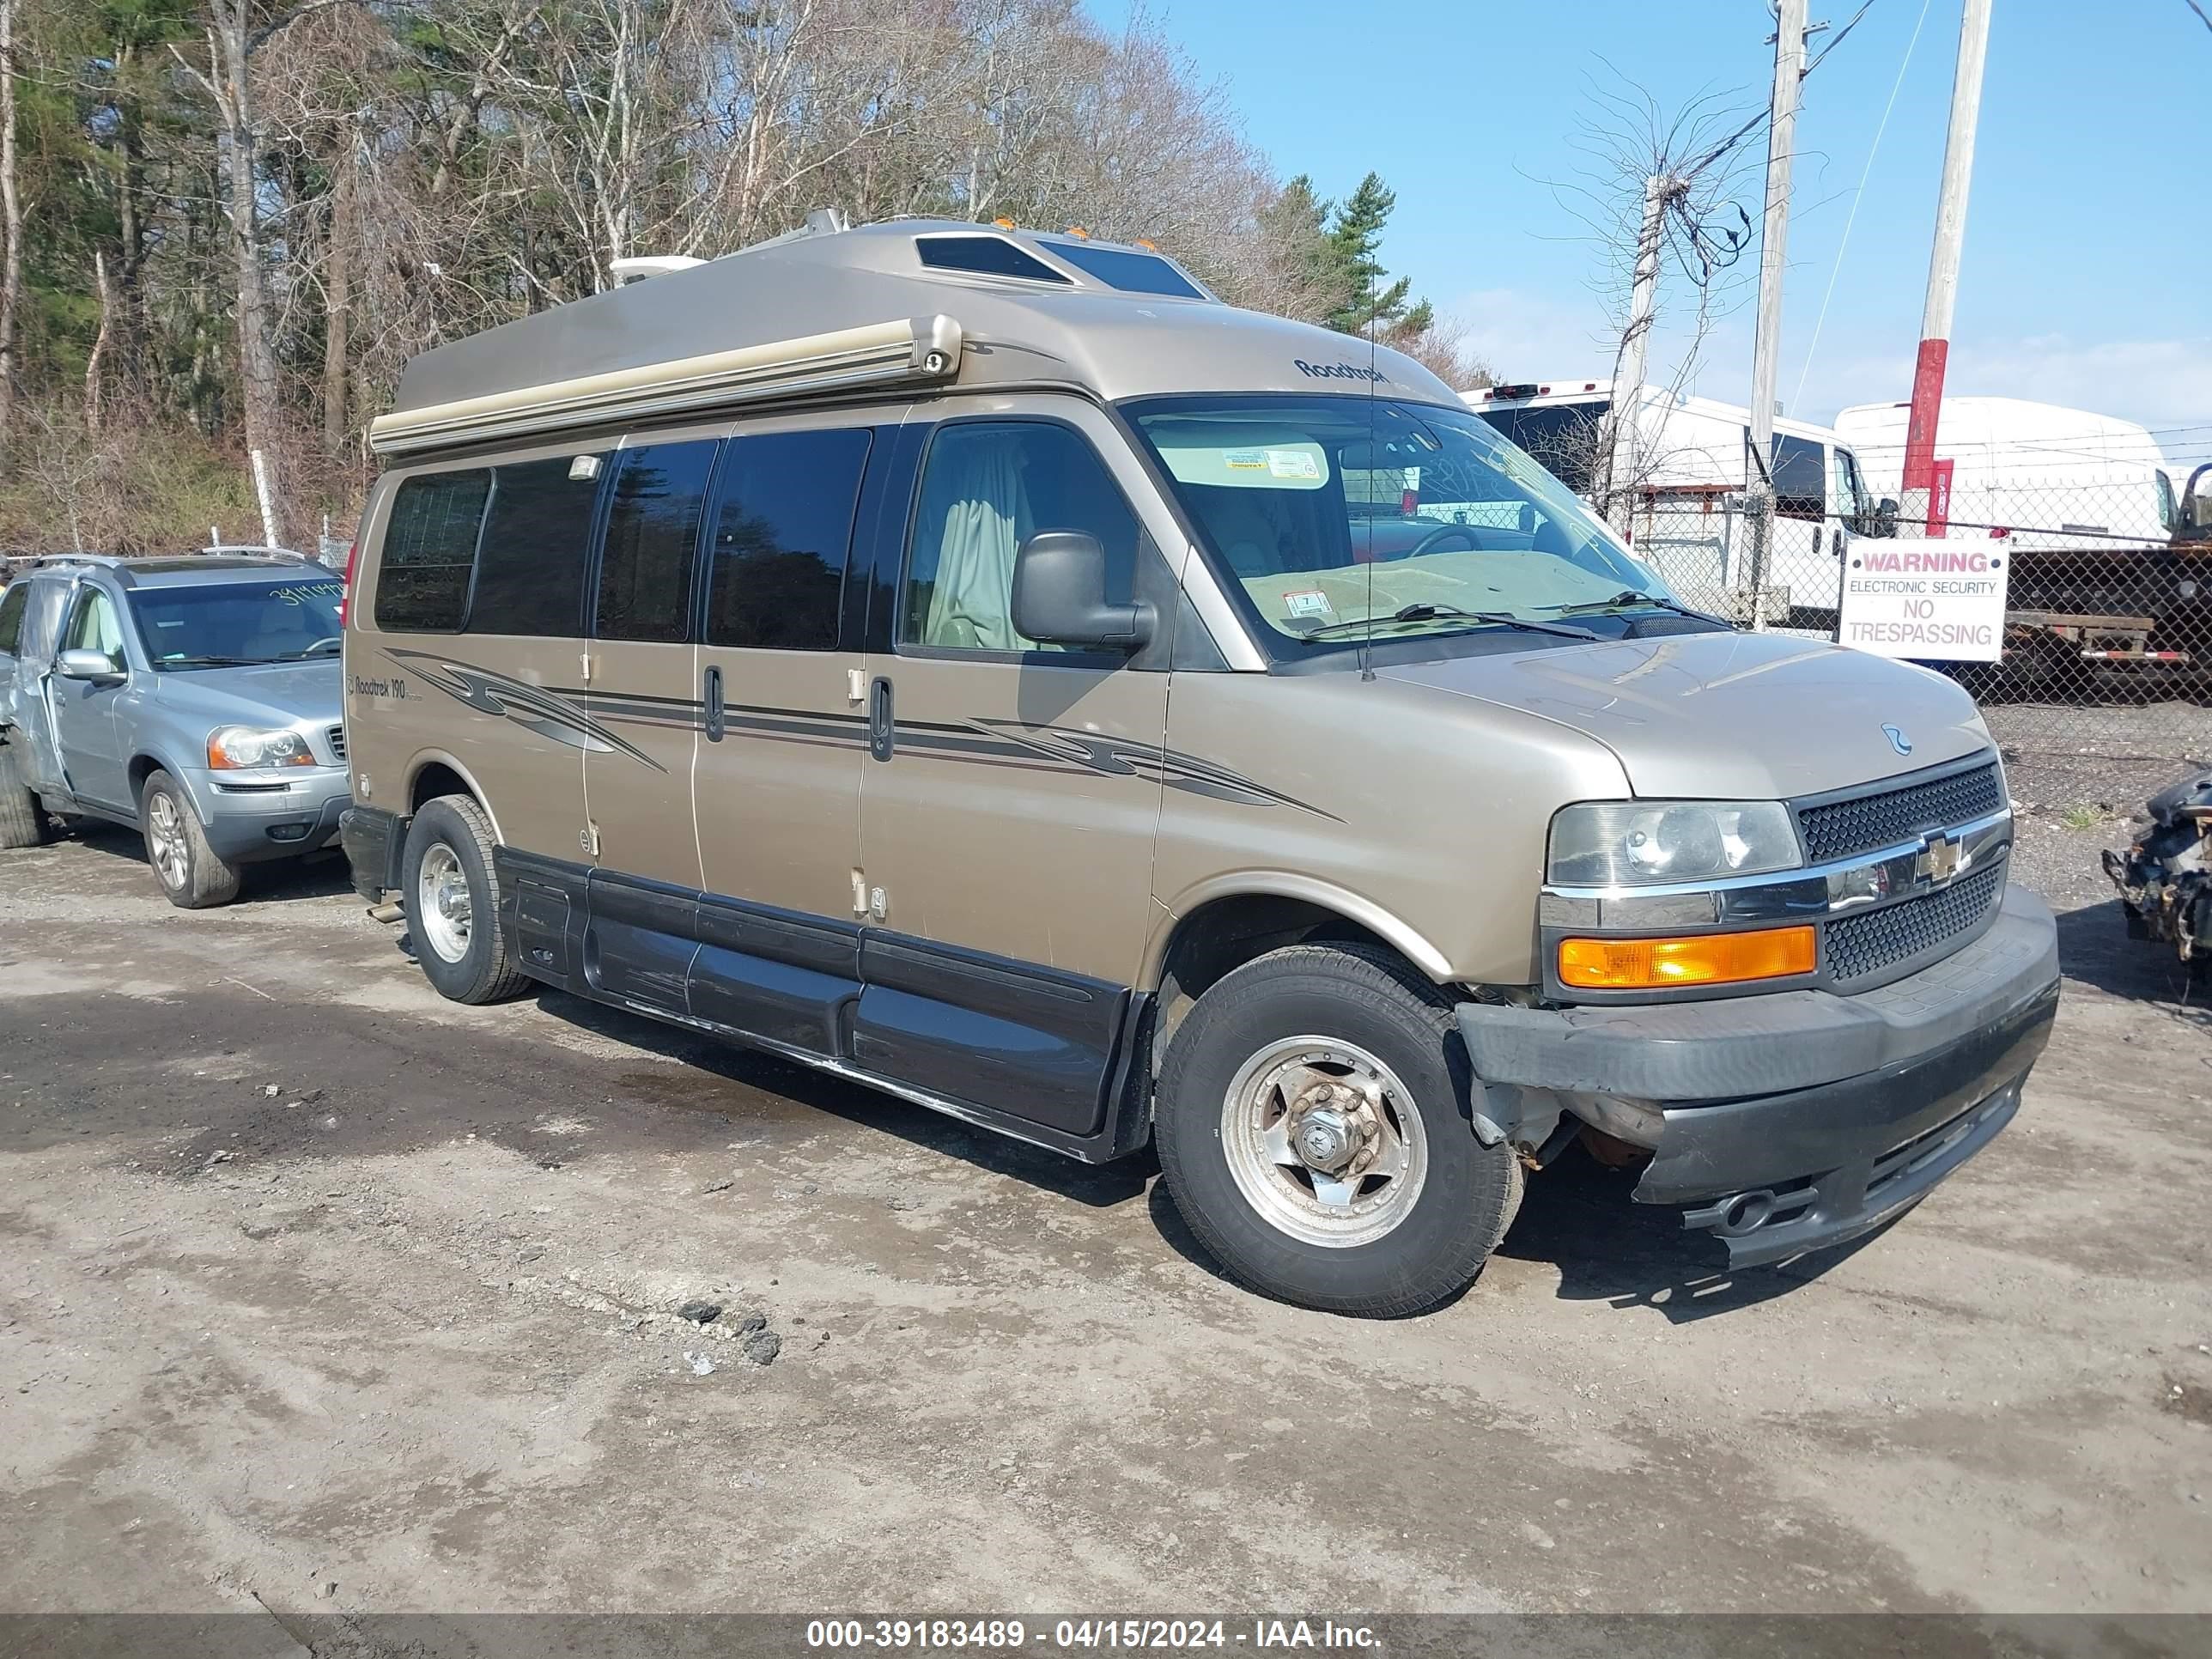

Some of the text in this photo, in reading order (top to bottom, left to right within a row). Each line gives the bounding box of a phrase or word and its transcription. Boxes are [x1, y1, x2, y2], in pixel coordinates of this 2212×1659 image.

[1294, 359, 1391, 384] Roadtrek
[1863, 552, 1988, 572] WARNING
[1850, 580, 1997, 594] ELECTRONIC SECURITY
[1903, 599, 1935, 618] NO
[1849, 622, 1992, 645] TRESPASSING
[355, 675, 389, 697] Roadtrek
[391, 678, 405, 699] 190
